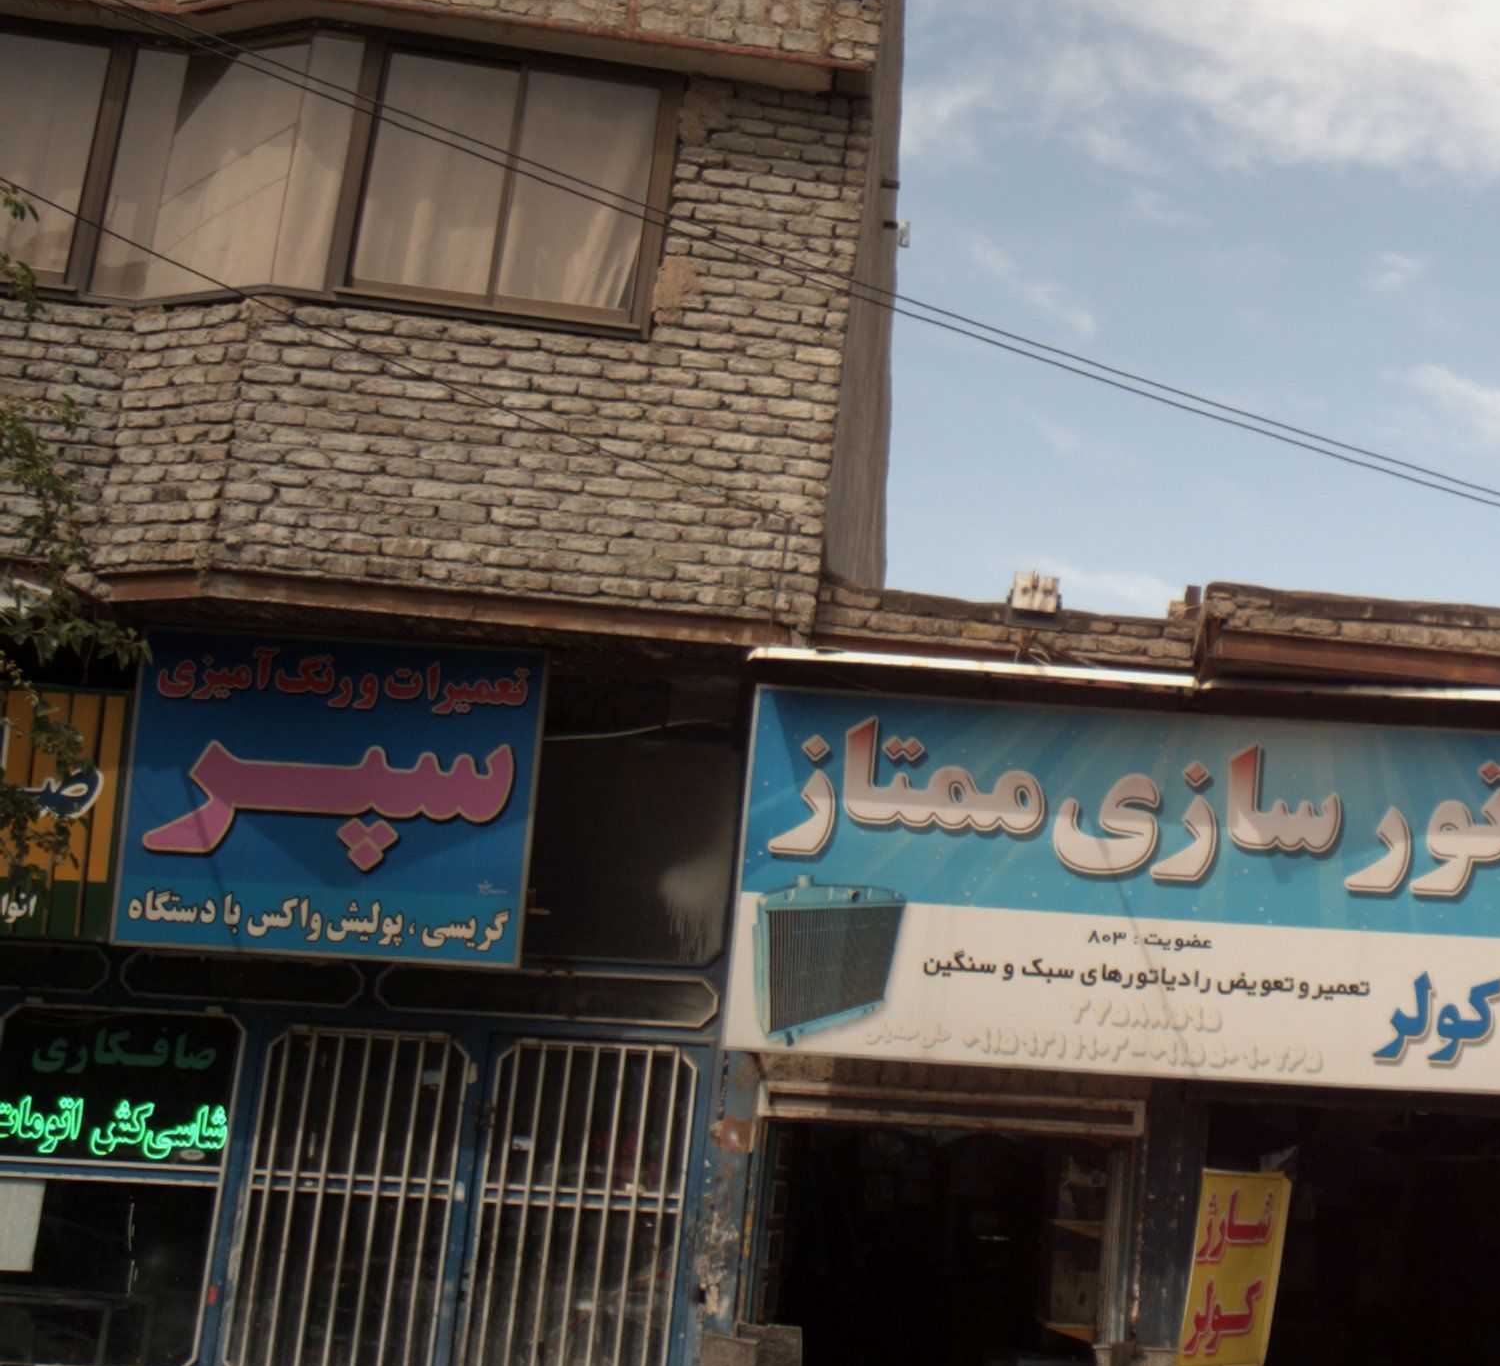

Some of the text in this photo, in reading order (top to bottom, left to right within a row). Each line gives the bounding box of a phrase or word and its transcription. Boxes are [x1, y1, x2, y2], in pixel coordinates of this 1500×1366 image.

[157, 646, 280, 700] آمیزی
[352, 673, 379, 710] و
[385, 664, 530, 714] تعمیرات
[142, 739, 515, 873] سپر
[768, 715, 1047, 857] ممتاز
[1053, 741, 1342, 883] سازی
[127, 888, 216, 925] دستگاه
[223, 892, 243, 934] با
[246, 896, 323, 942] واکس
[326, 900, 405, 947] پولیش
[922, 950, 1371, 1001] تعمیر و تعویض رادیاتورهای سبک و سنگین
[31, 1028, 217, 1075] صافکاری
[1195, 1186, 1274, 1261] شارژ
[1183, 1276, 1264, 1356] کولر
